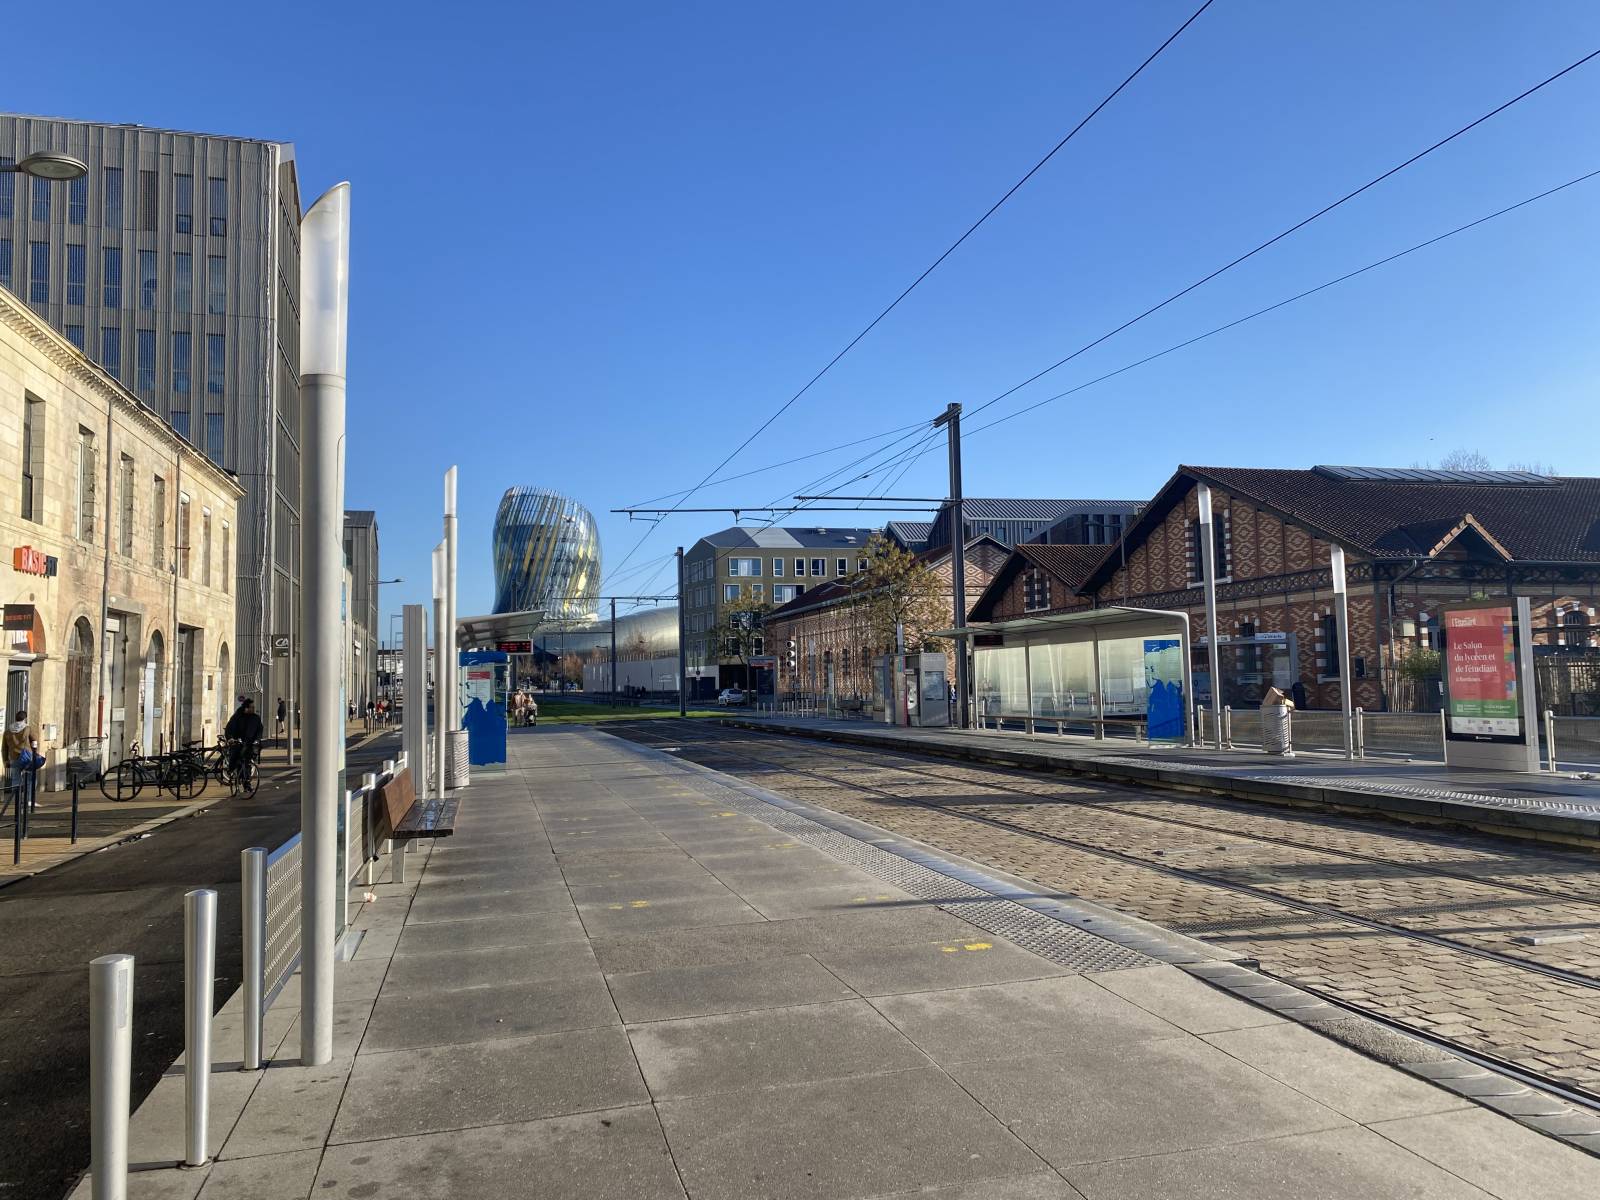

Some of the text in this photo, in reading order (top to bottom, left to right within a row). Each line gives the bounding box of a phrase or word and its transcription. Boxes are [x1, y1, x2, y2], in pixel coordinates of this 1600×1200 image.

[1453, 640, 1483, 650] Le Salon
[1488, 653, 1496, 661] et
[1455, 665, 1464, 673] de
